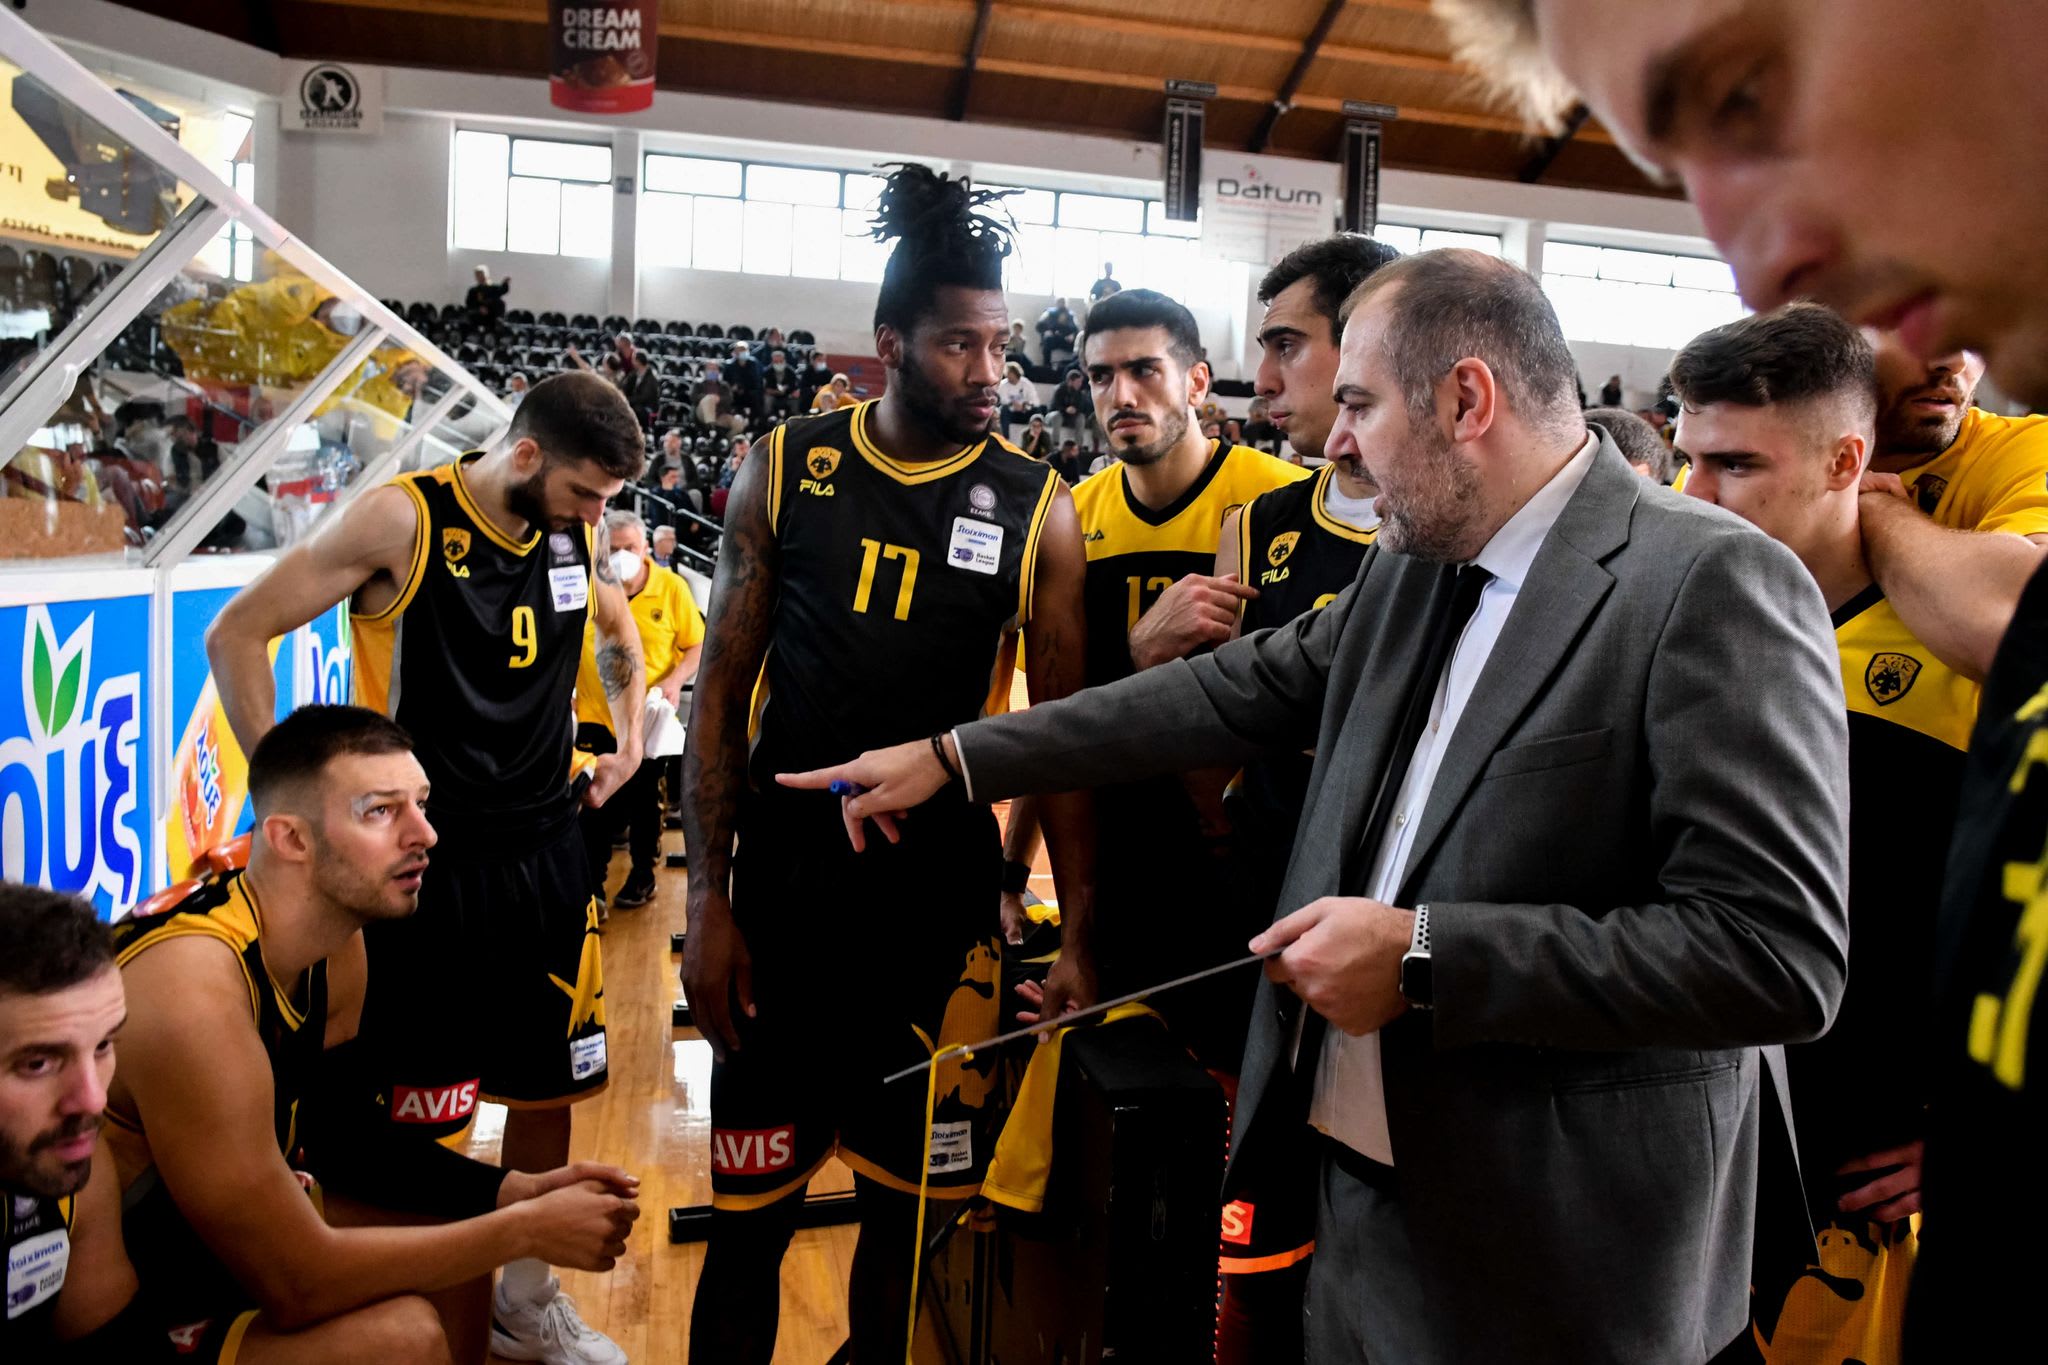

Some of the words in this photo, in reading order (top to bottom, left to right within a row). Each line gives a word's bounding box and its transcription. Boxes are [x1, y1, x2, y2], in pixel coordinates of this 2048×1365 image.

[563, 8, 641, 28] DREAM
[563, 28, 641, 50] CREAM
[1217, 178, 1322, 205] Datum
[799, 478, 835, 497] FILA
[852, 537, 921, 622] 17
[1260, 565, 1291, 587] FILA
[508, 605, 538, 669] 9
[396, 1083, 477, 1120] AVIS
[713, 1130, 790, 1169] AVIS
